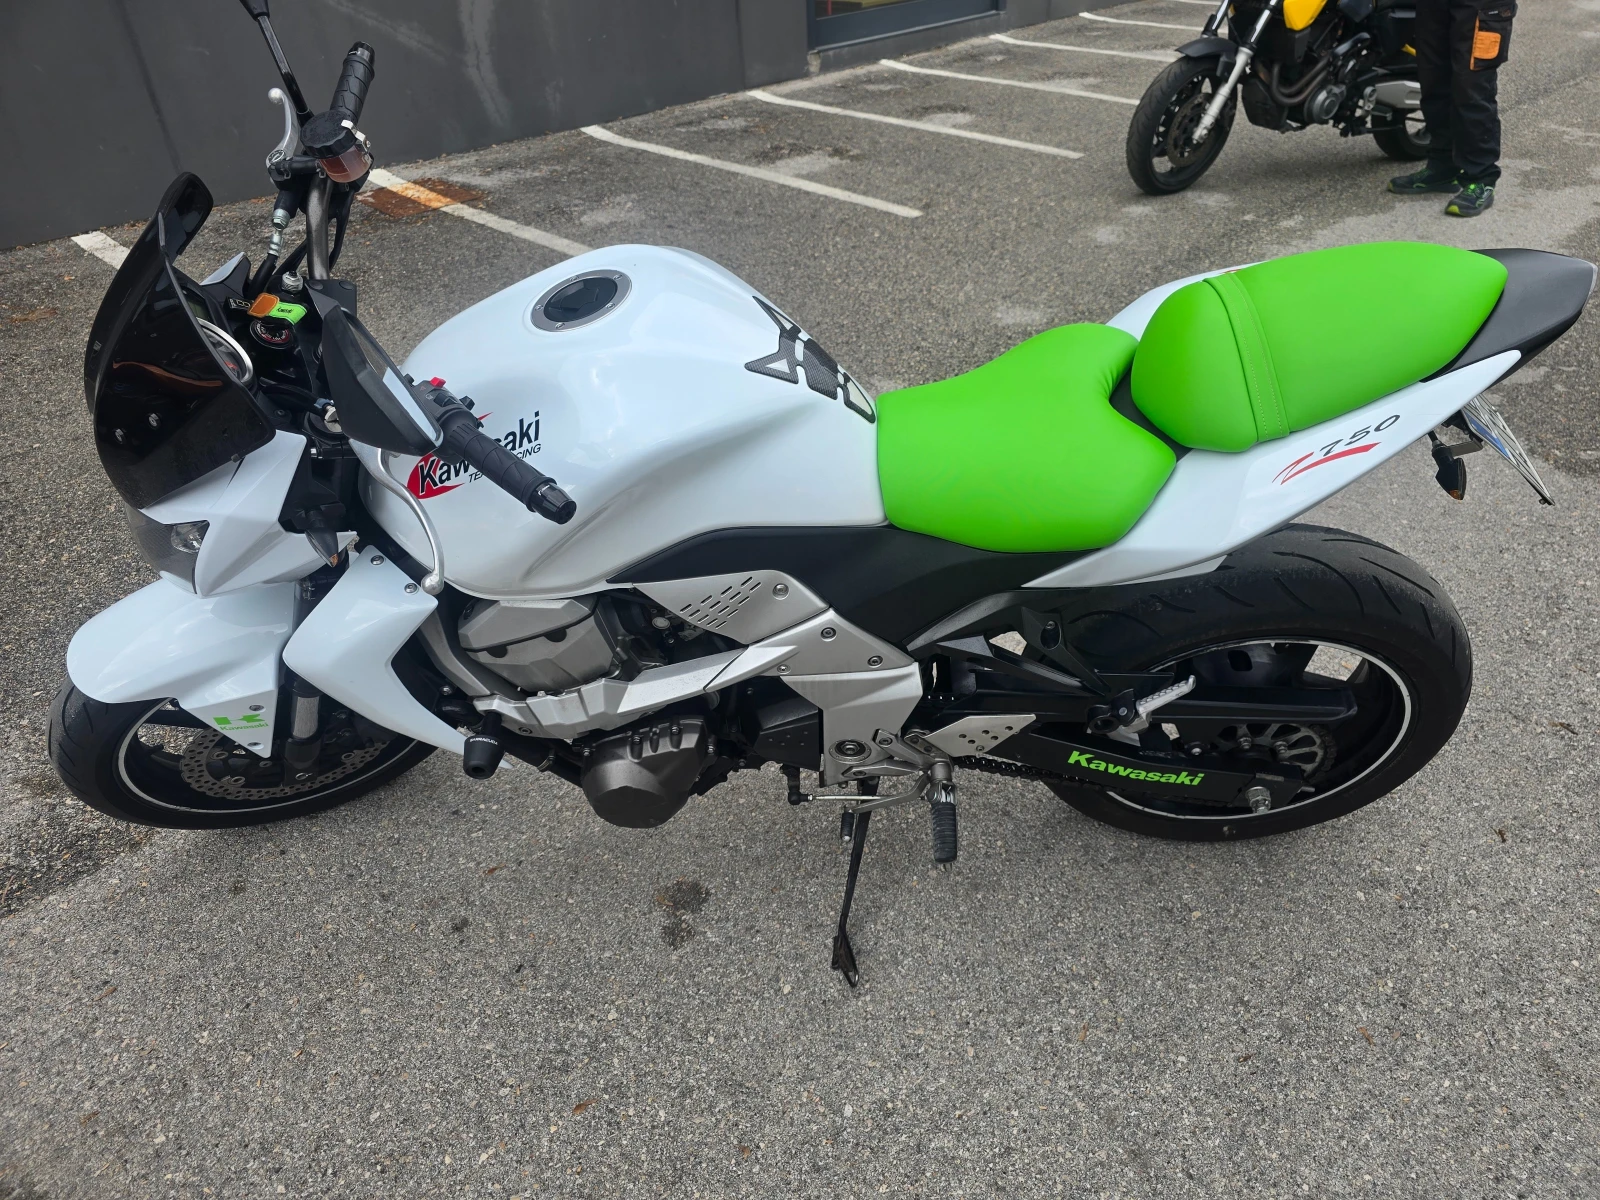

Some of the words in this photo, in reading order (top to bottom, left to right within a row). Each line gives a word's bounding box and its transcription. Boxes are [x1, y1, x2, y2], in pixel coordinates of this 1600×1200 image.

[419, 411, 540, 495] Kawaki
[515, 443, 542, 459] CING
[219, 722, 269, 731] Kawasaki
[1067, 750, 1205, 786] Kawasaki
